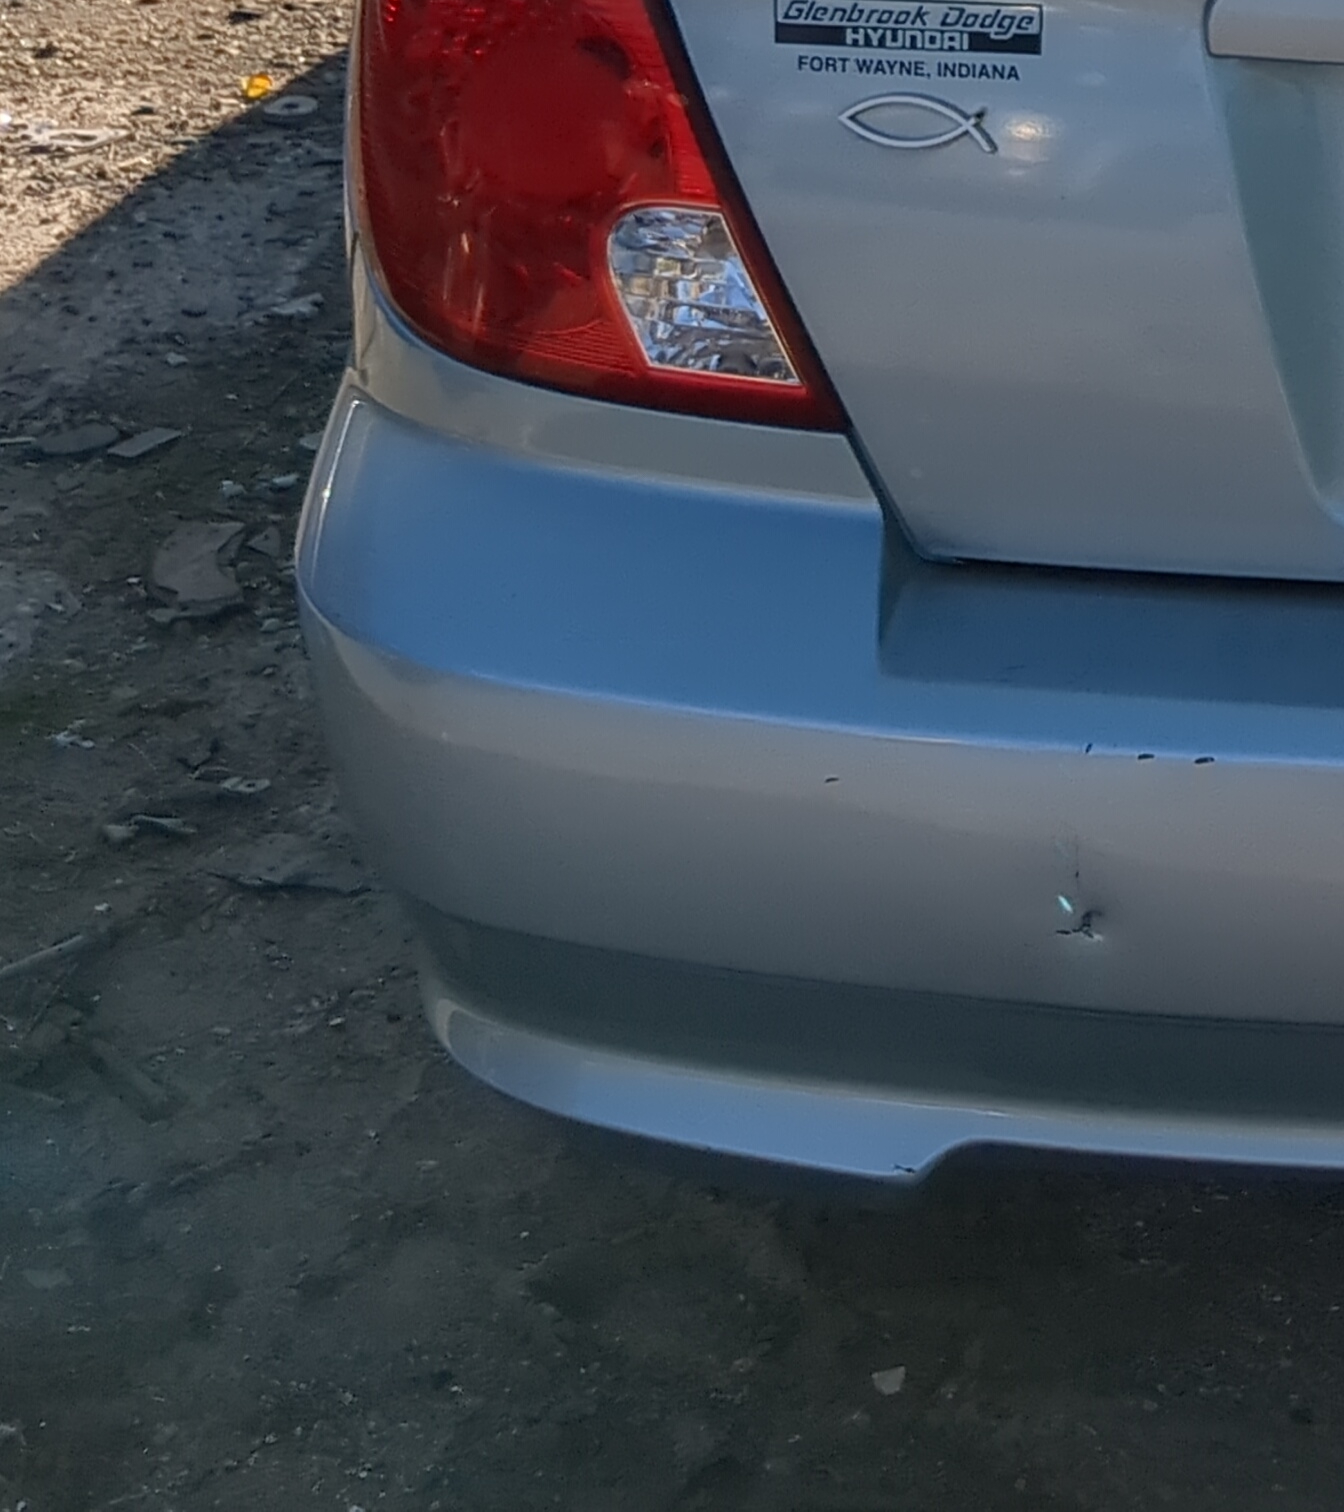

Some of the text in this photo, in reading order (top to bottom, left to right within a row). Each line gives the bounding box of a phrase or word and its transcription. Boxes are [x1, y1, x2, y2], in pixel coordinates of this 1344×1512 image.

[940, 5, 1035, 39] Dodge
[845, 28, 971, 51] HYUNDAI
[797, 55, 1020, 81] FORT WAYNE, INDIANA
